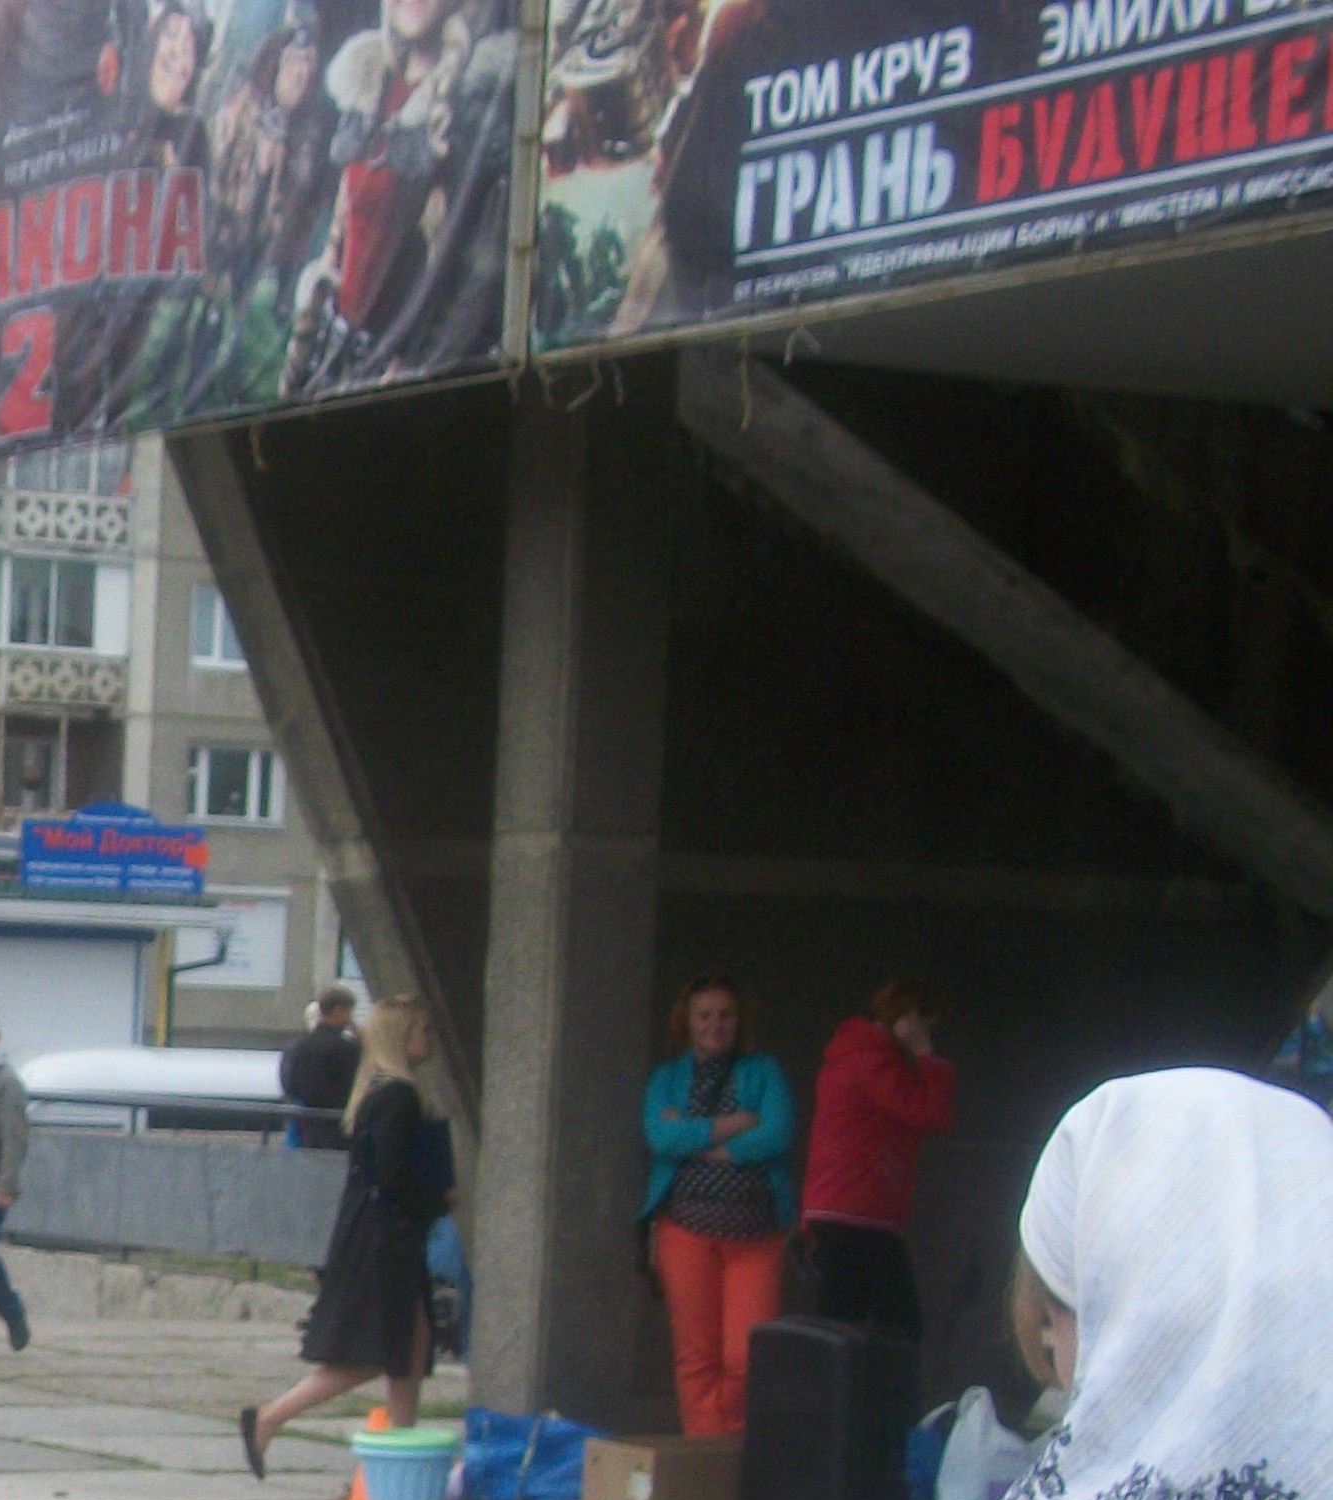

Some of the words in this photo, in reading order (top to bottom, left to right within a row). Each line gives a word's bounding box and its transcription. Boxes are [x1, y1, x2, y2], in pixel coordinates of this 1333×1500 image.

[733, 121, 957, 251] ГРАНЬ
[976, 30, 1333, 205] БУДУЩЕ
[742, 57, 841, 135] ТОМ
[848, 24, 974, 111] КРУЗ
